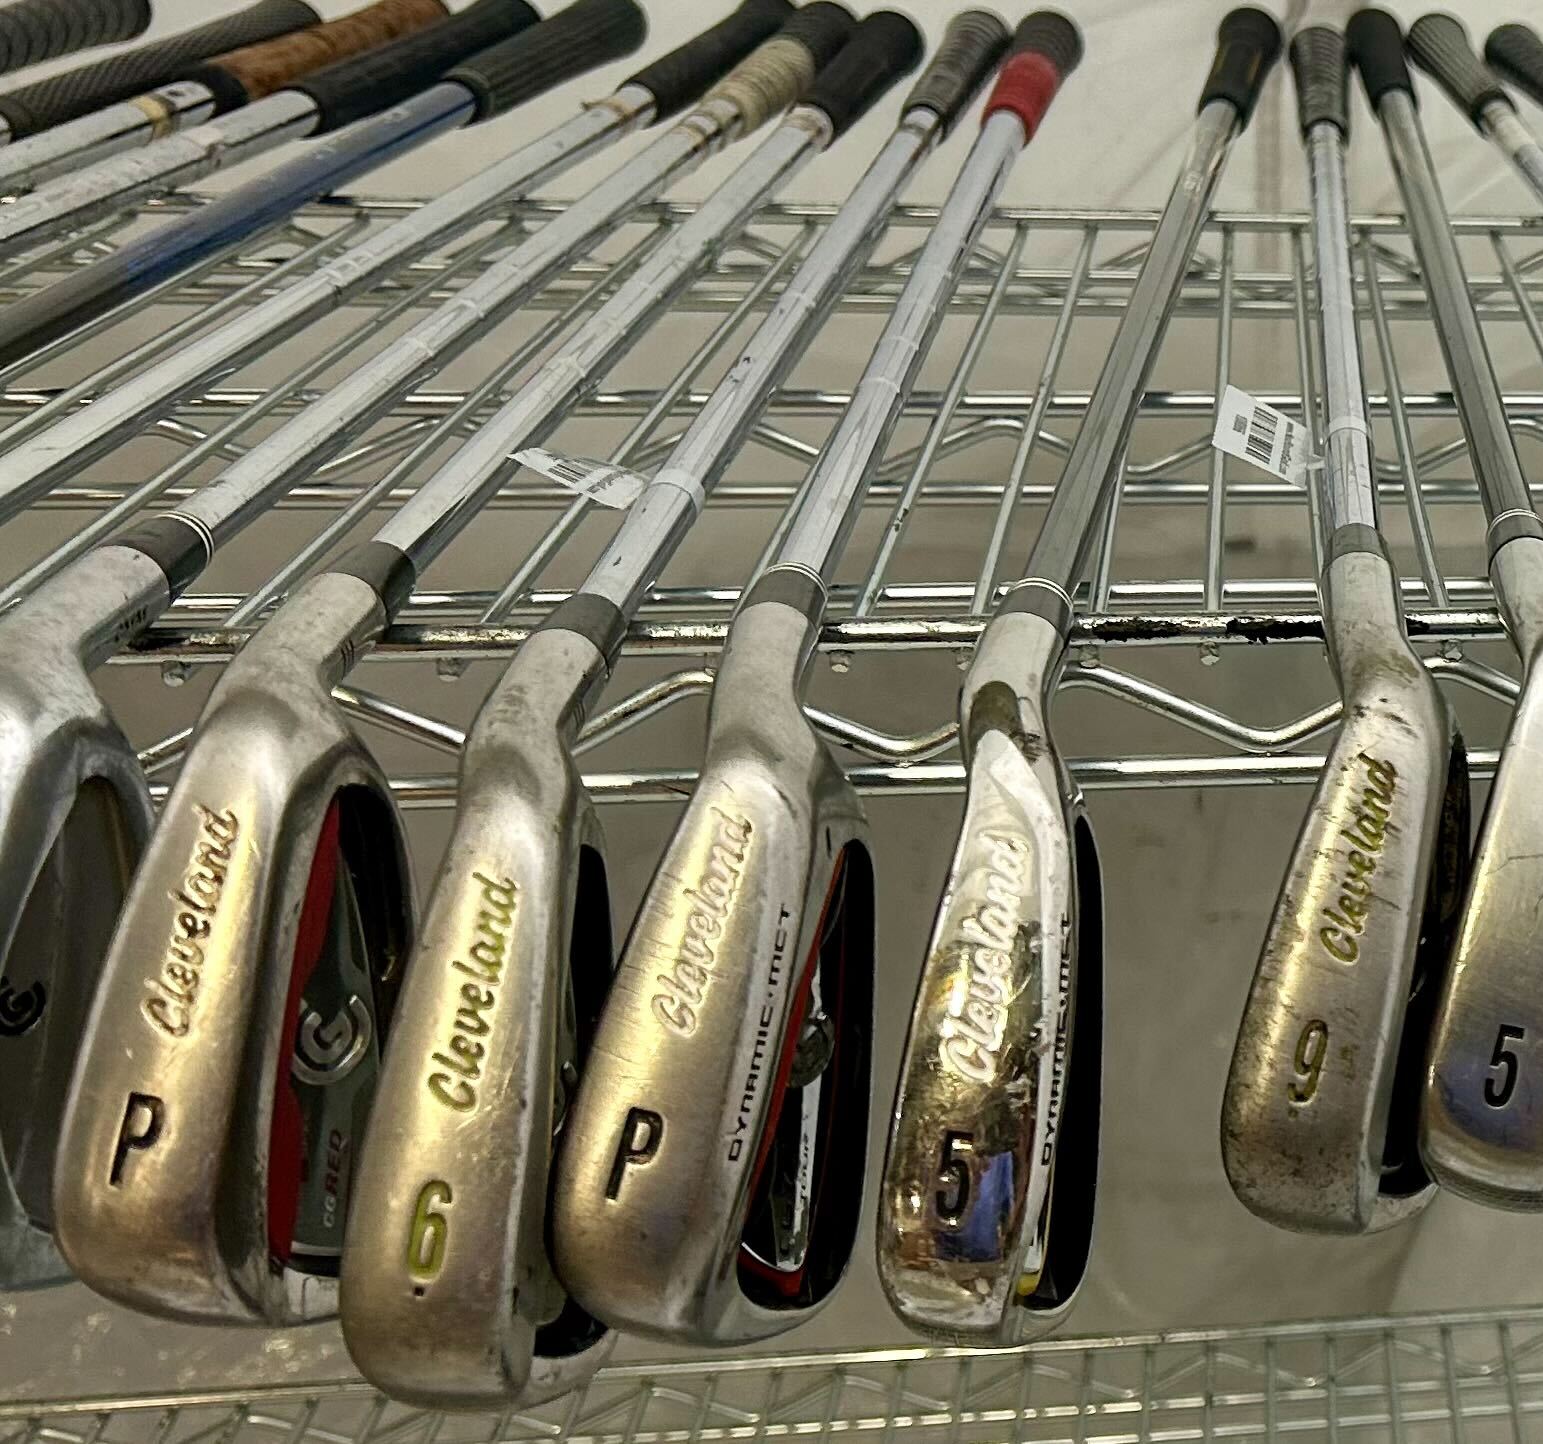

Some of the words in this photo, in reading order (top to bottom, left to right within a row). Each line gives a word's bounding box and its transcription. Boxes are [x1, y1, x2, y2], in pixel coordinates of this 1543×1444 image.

[140, 803, 239, 1040] Cleveland
[651, 806, 753, 1038] Cleveland
[1320, 752, 1399, 966] Cleveland
[425, 871, 519, 1114] Cleveland
[940, 830, 1031, 1083] Cleveland
[109, 1091, 168, 1188] P
[1483, 1023, 1526, 1108] 5
[407, 1178, 453, 1283] 6
[605, 1105, 666, 1203] P
[935, 1129, 974, 1233] 5
